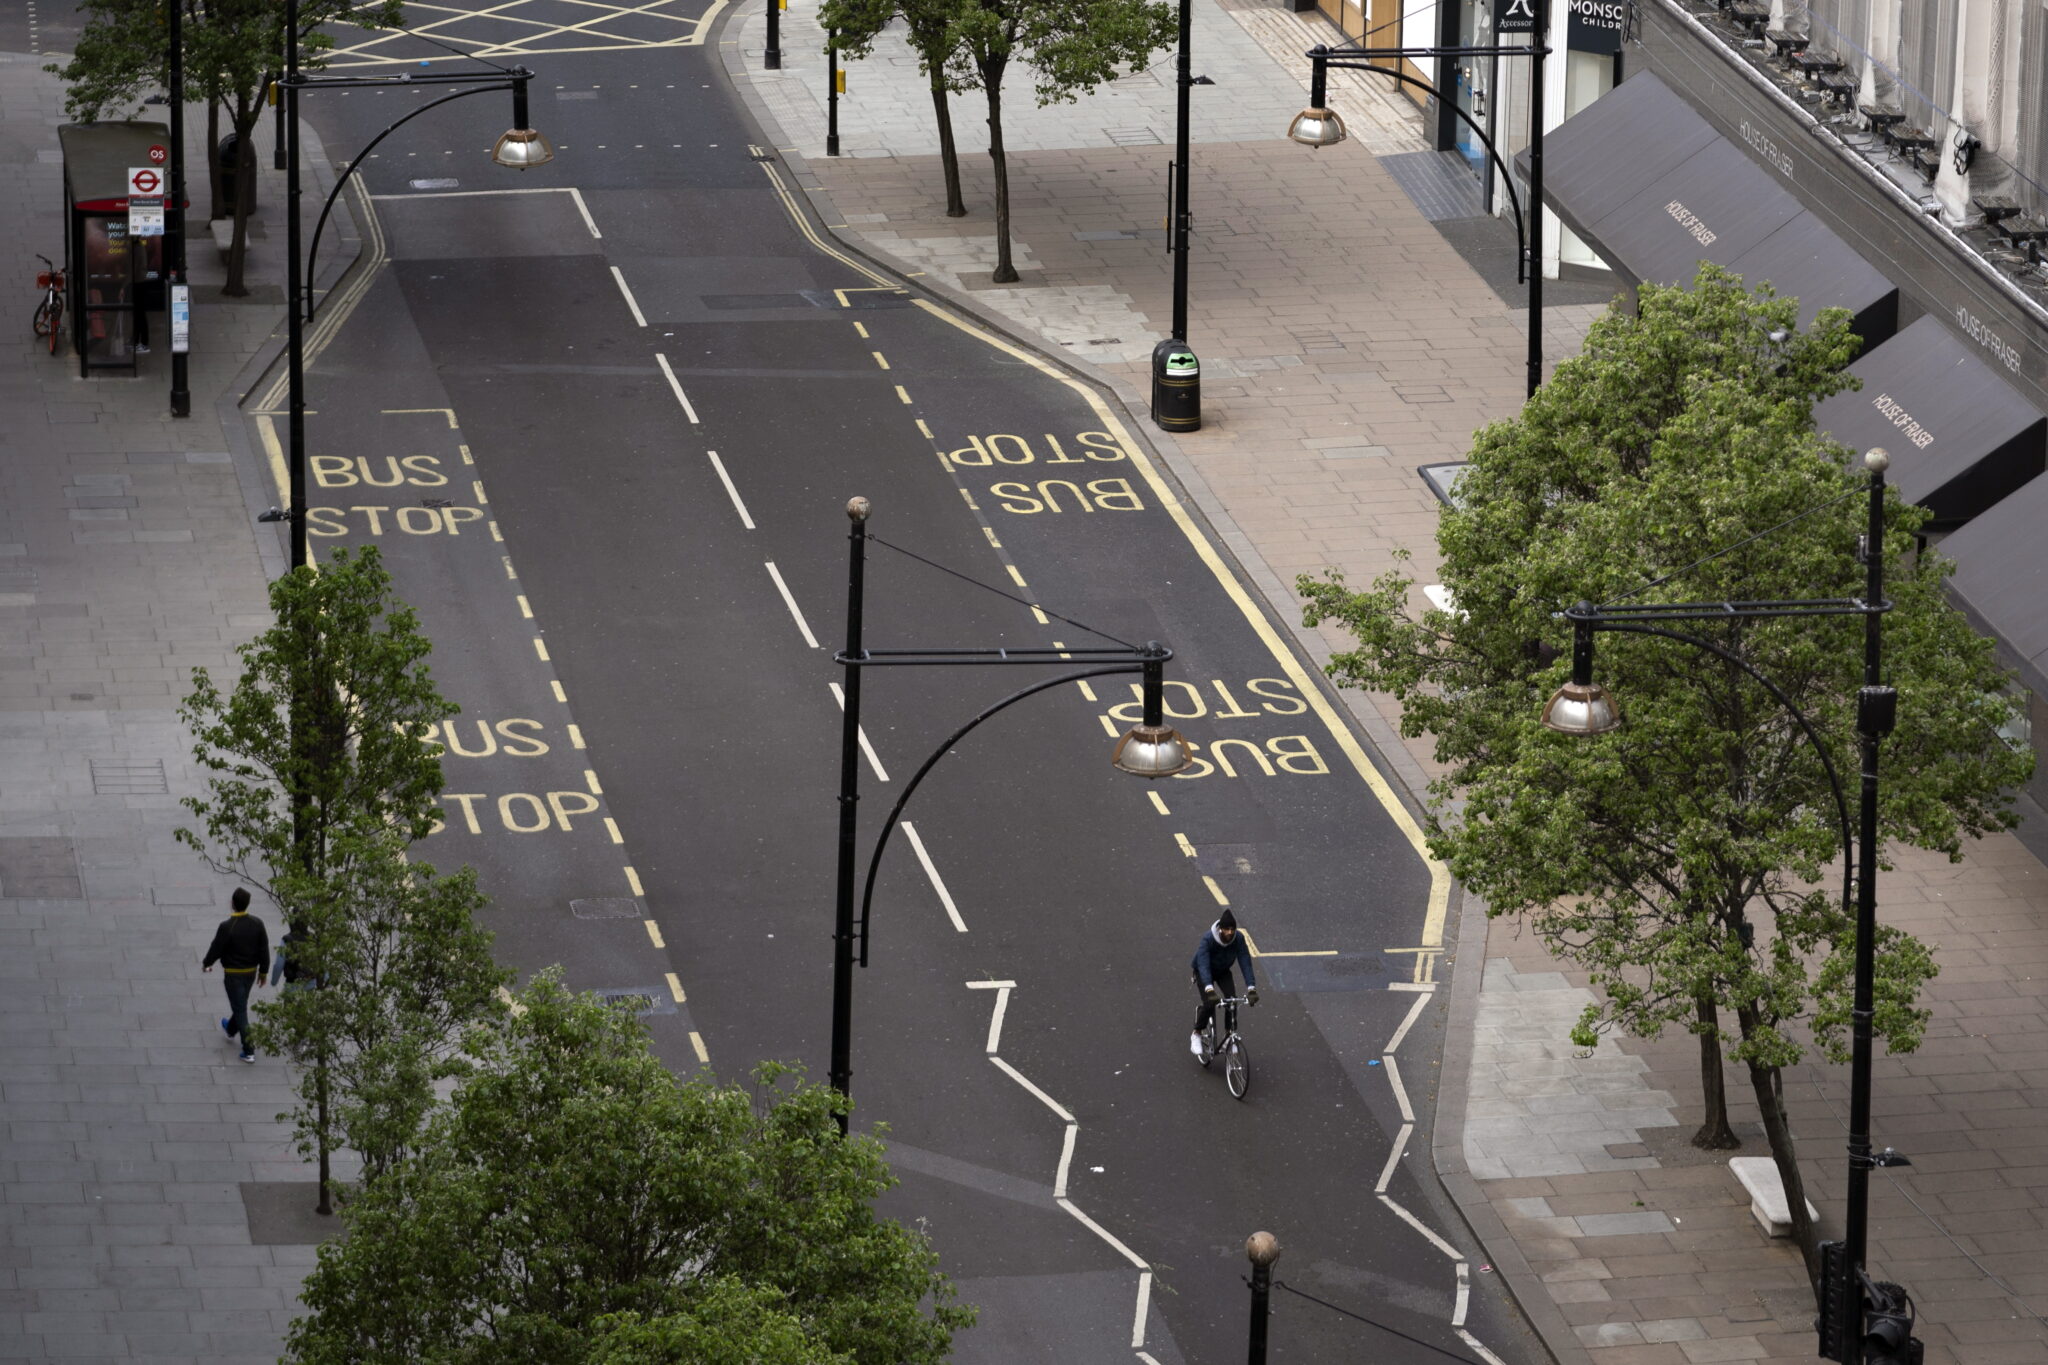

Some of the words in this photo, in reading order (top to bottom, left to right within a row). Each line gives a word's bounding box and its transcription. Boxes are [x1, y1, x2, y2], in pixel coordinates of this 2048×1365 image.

[1499, 18, 1534, 28] Accessor
[1569, 0, 1622, 20] MONSO
[1582, 17, 1621, 30] CHILDR
[150, 149, 164, 159] OS
[1739, 117, 1761, 151] HOUSE
[1760, 135, 1770, 158] OF
[1768, 141, 1794, 180] FRASER
[1664, 199, 1691, 222] HOUSE
[1682, 215, 1699, 228] OF
[107, 222, 128, 230] Watc
[1688, 221, 1717, 247] FRASER
[1956, 303, 1981, 342] HOUSE
[1980, 324, 1992, 349] OF
[1990, 331, 2021, 377] FRASER
[1871, 393, 1904, 420] HOUSE
[1893, 413, 1913, 428] OF
[1901, 420, 1935, 450] FRASER
[949, 431, 1126, 467] STOP
[310, 455, 449, 487] BUS
[990, 478, 1145, 514] BUS
[305, 506, 484, 537] STOP
